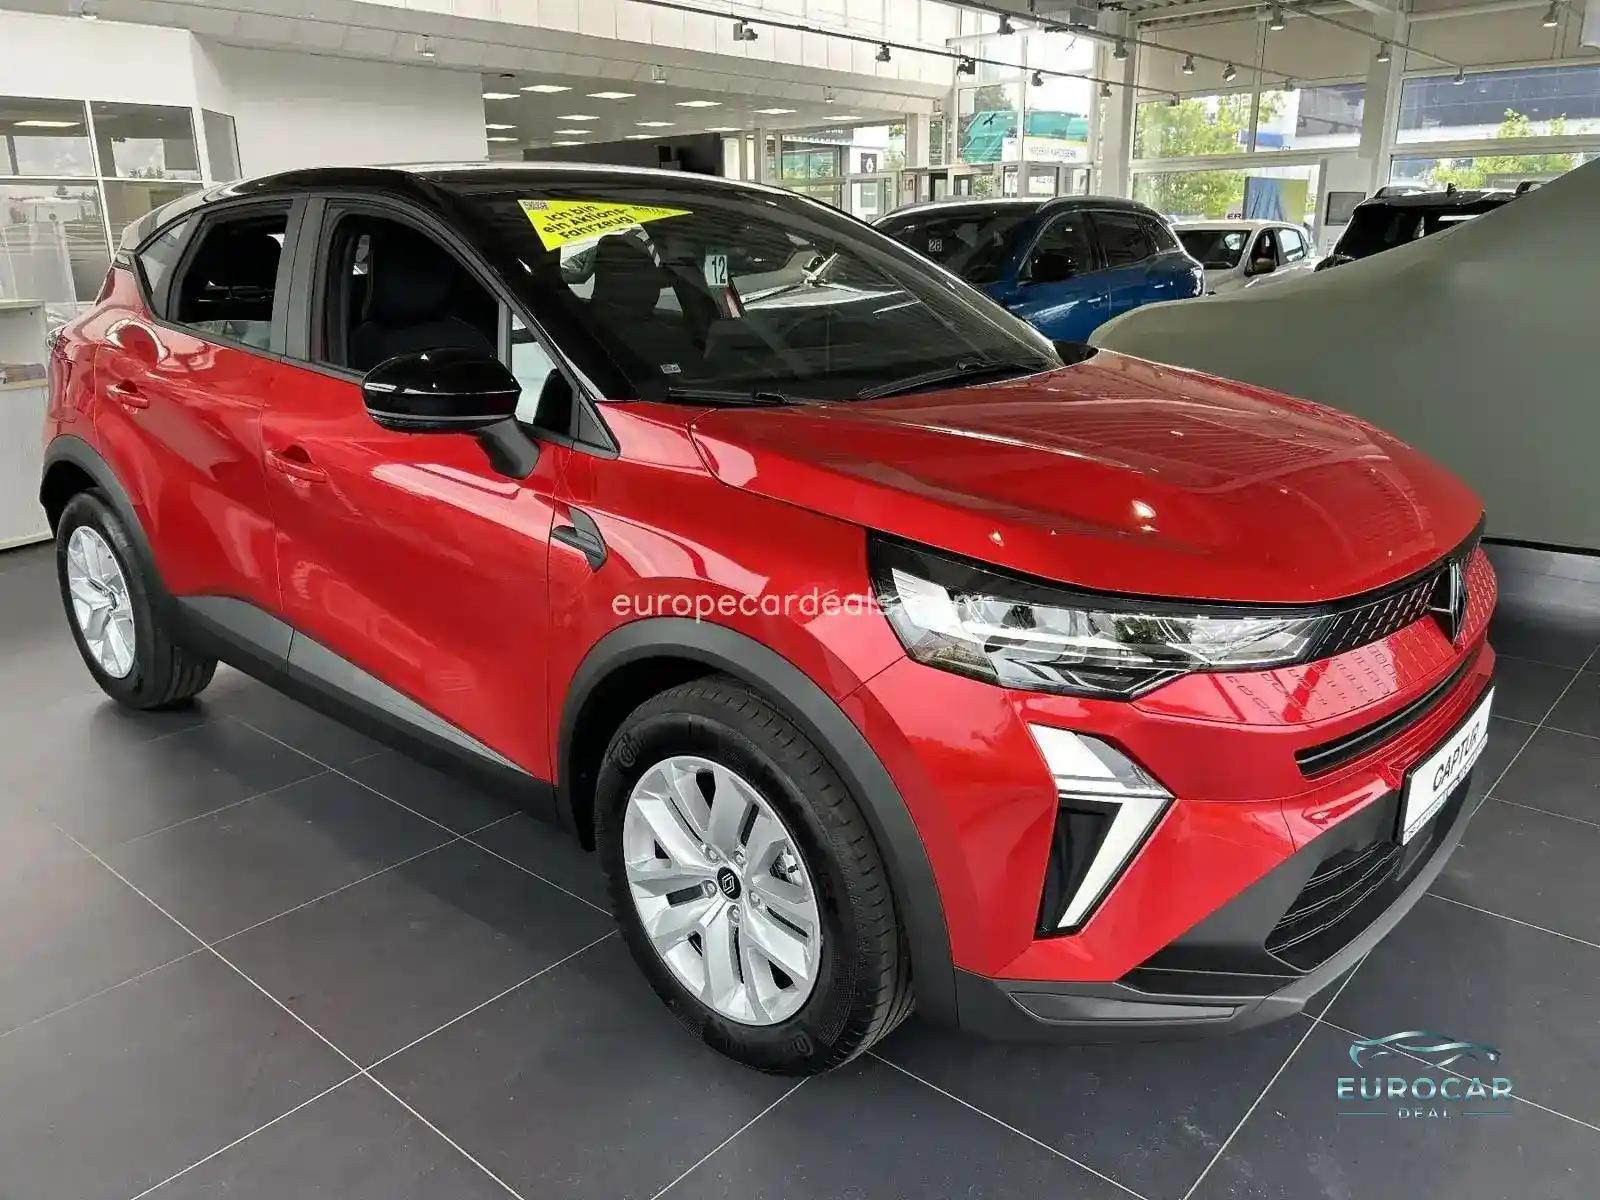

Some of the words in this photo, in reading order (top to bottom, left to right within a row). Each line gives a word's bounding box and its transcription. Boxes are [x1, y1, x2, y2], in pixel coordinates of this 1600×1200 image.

[544, 211, 573, 221] Ich
[569, 205, 599, 215] bin
[543, 222, 570, 233] ein
[711, 255, 727, 284] 12
